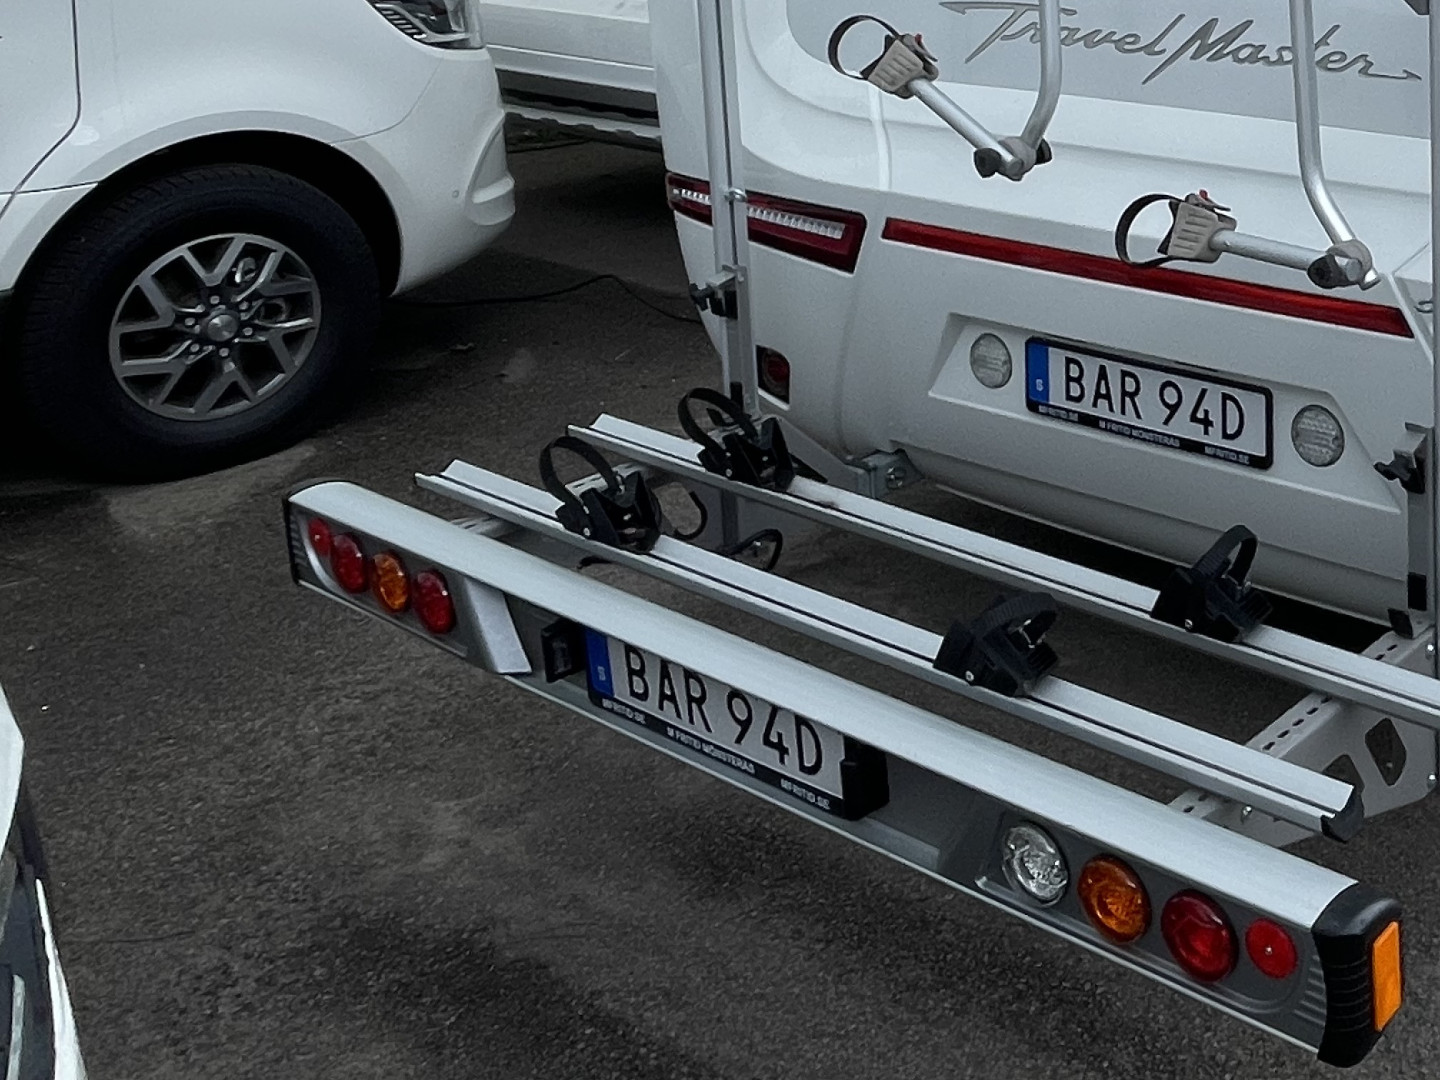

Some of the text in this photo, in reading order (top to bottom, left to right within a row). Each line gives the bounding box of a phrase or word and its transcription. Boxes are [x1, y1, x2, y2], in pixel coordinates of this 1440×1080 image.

[938, 0, 1422, 85] Travel Master
[1064, 355, 1246, 442] BAR 94D
[624, 642, 824, 777] BAR 94D
